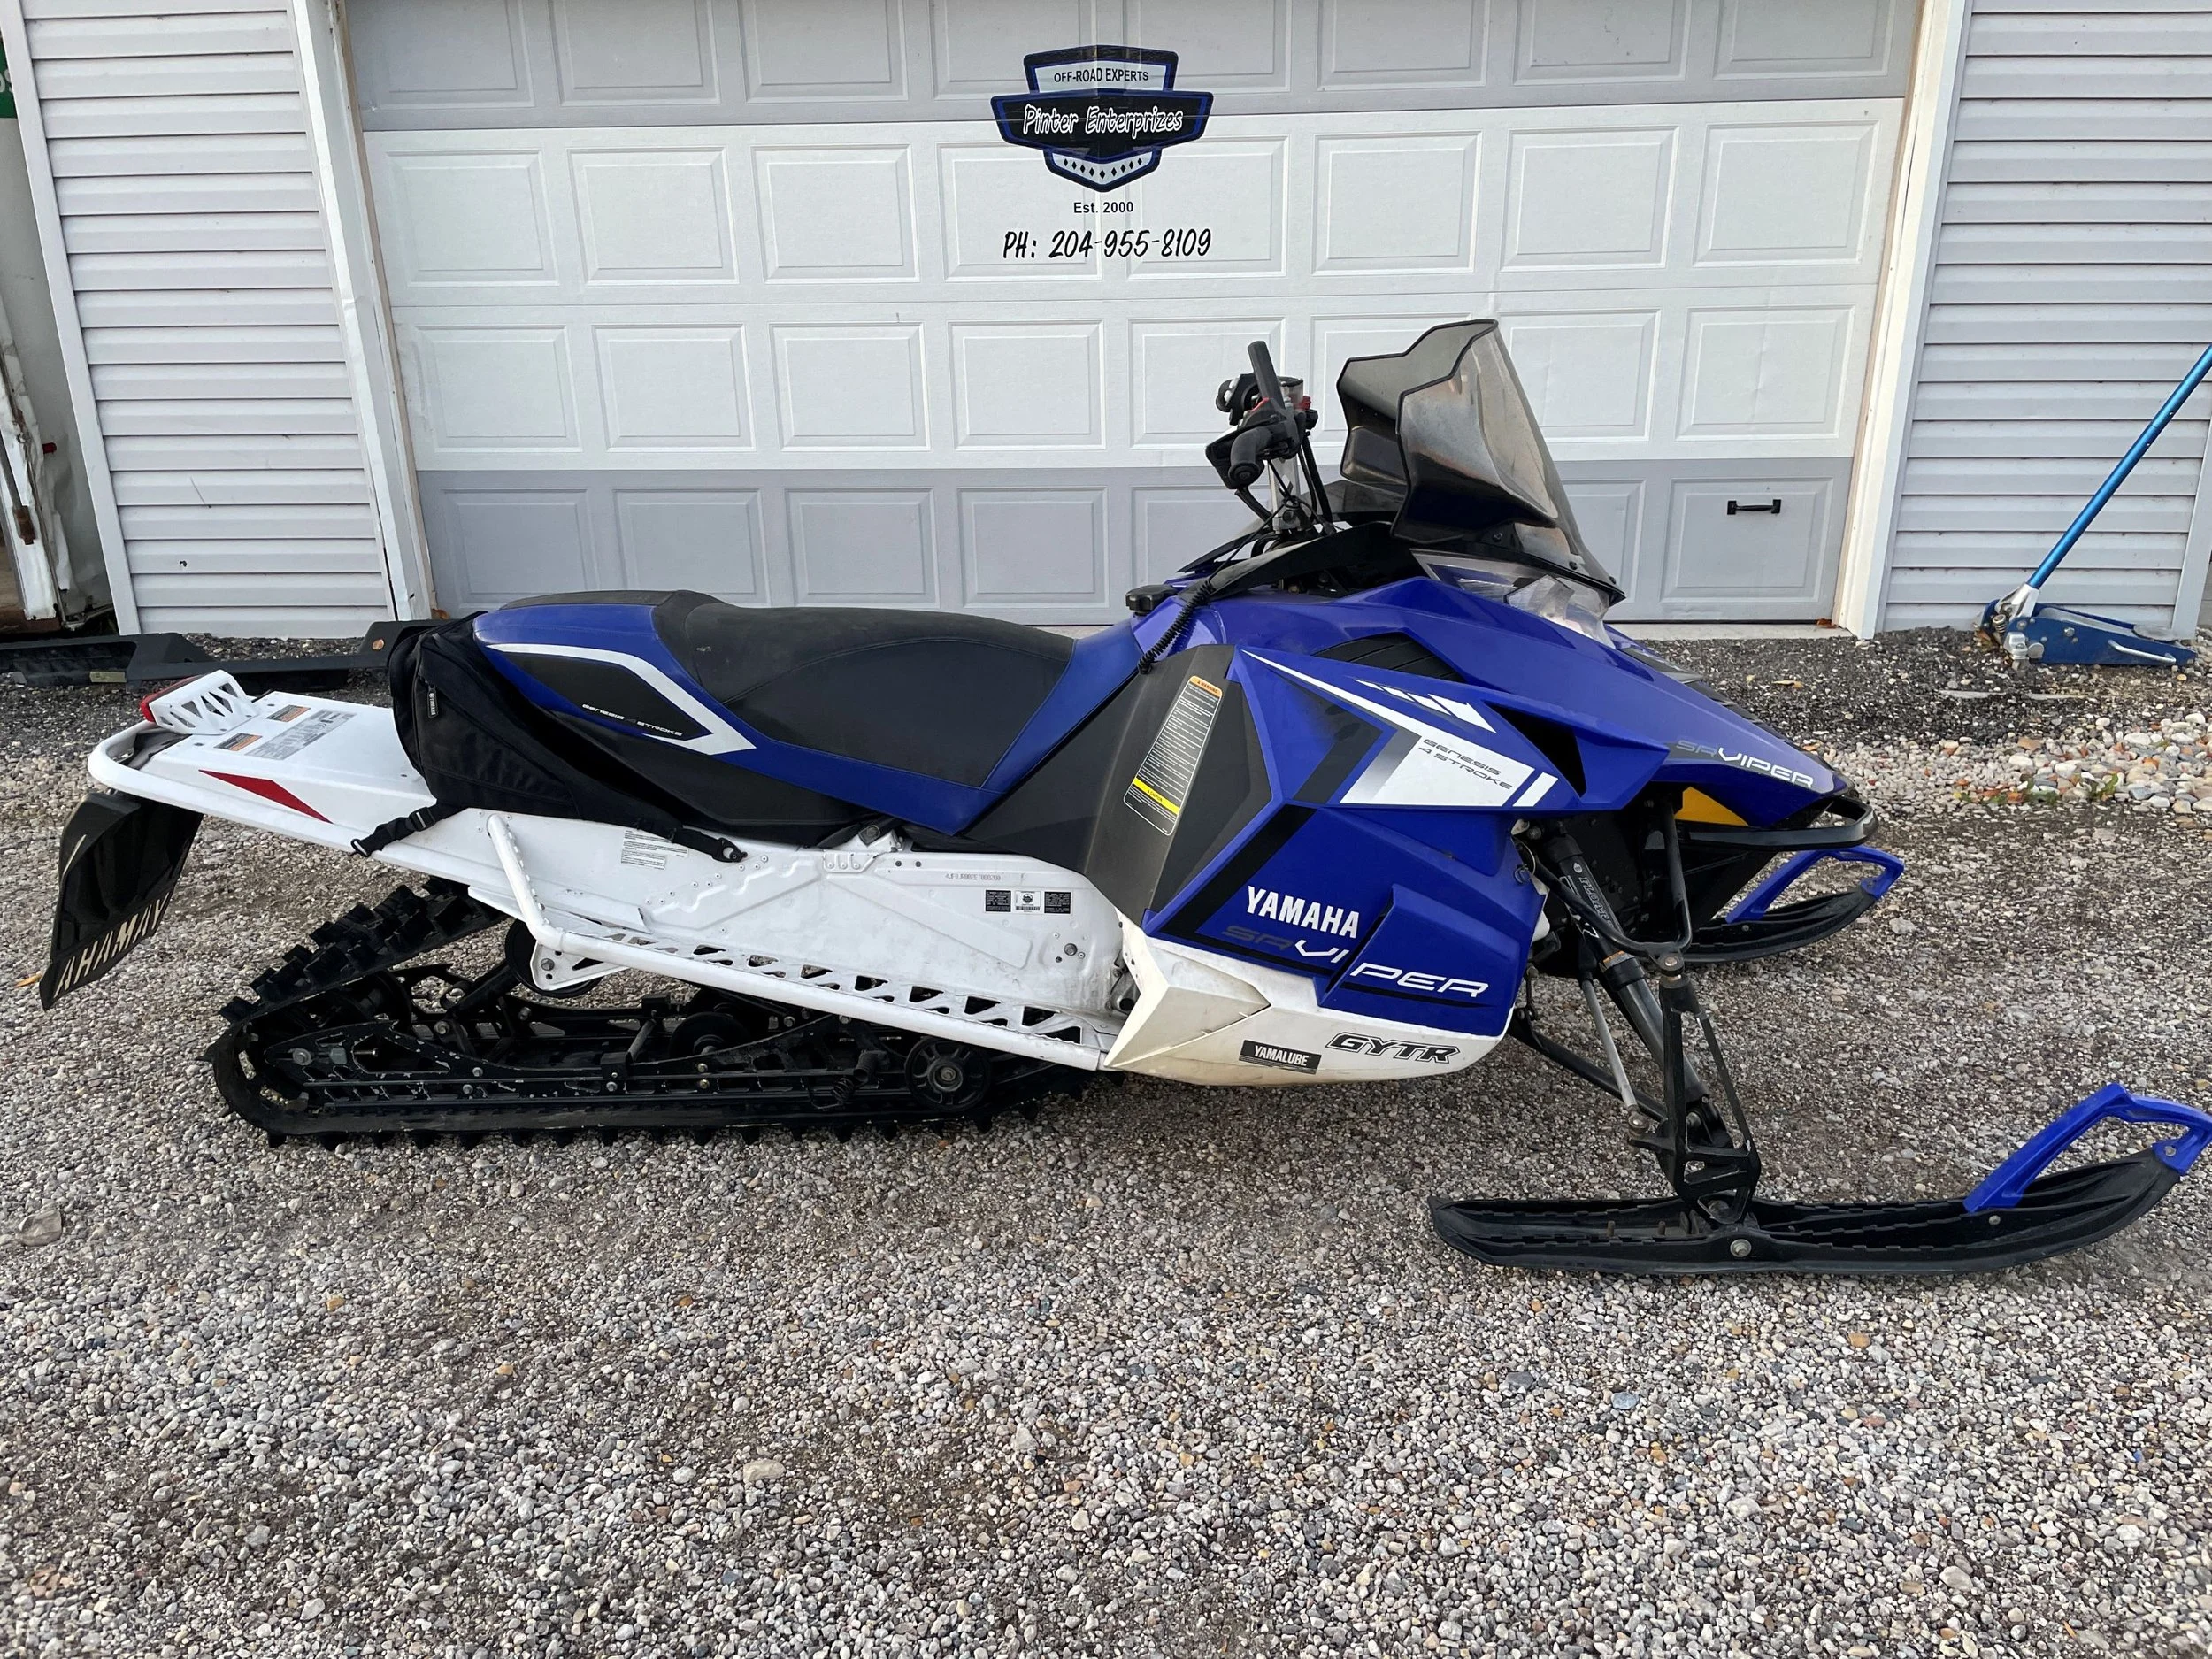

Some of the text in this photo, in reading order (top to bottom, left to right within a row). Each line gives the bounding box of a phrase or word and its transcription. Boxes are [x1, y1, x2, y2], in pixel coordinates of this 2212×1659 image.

[1054, 67, 1149, 83] OFF-ROAD EXPERTS
[1023, 104, 1184, 139] Pinter Enterprizes
[1073, 201, 1134, 214] Est. 2000
[1002, 228, 1212, 258] PH: 204-955-8109
[582, 703, 625, 720] GENESIS
[637, 721, 683, 736] STROKE
[1423, 739, 1502, 776] GENESIS
[1433, 753, 1512, 790] STROKE
[1246, 885, 1360, 939] YAMAHA
[1254, 1044, 1310, 1067] YAMALUBE
[1325, 1032, 1460, 1064] GYTR
